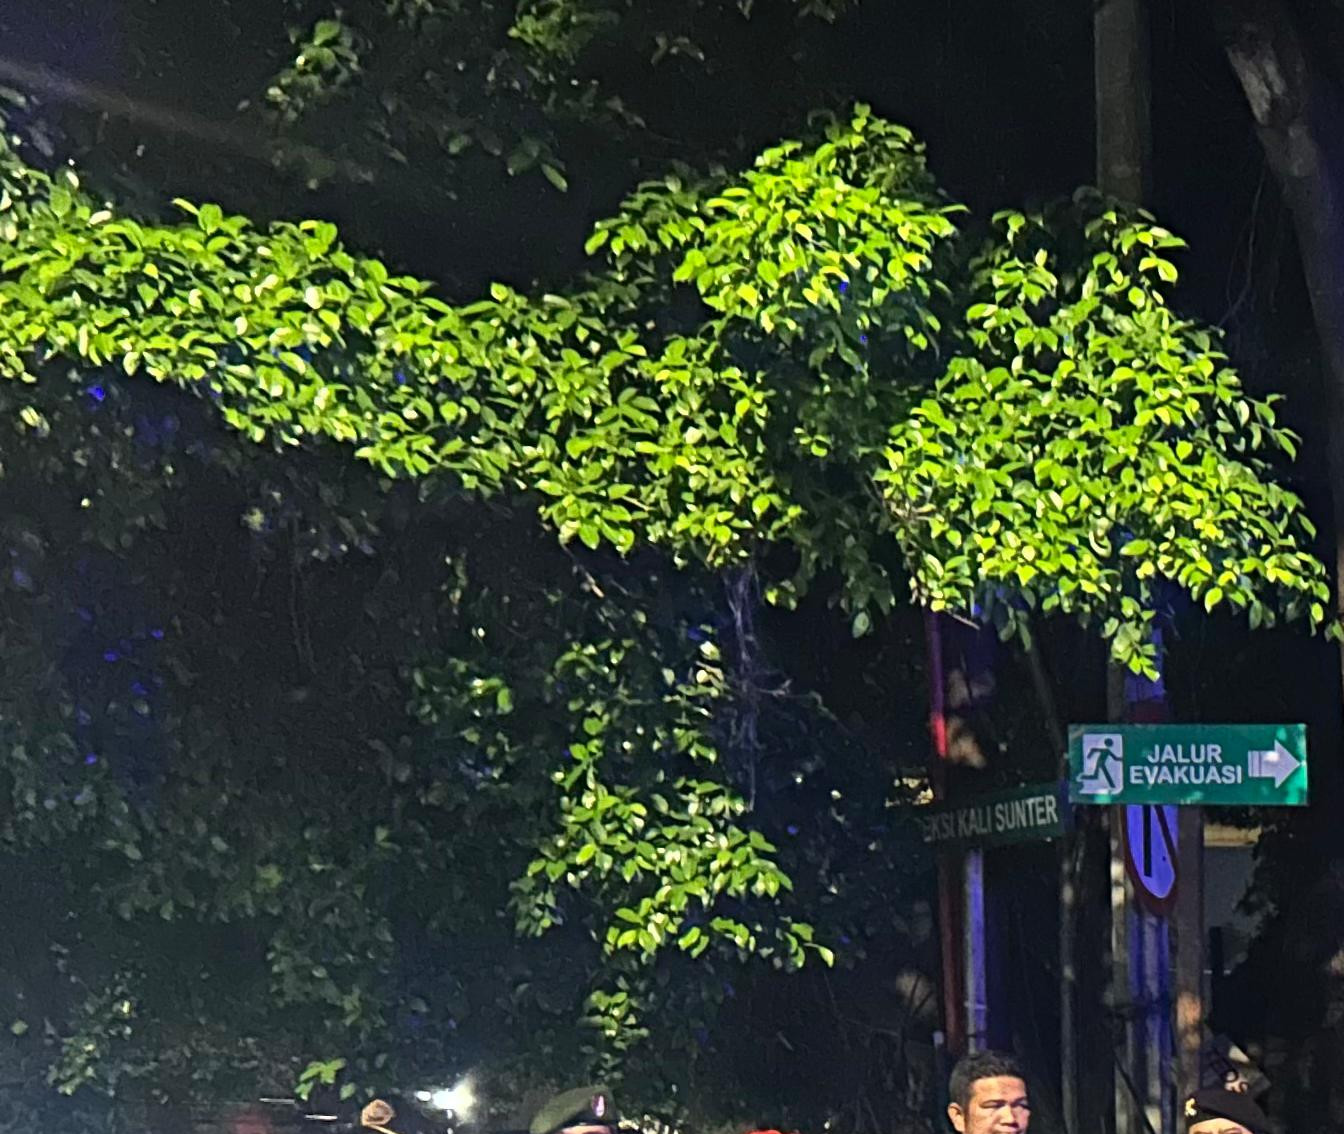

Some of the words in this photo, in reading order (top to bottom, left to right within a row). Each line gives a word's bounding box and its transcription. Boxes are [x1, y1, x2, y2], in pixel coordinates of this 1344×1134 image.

[1148, 744, 1223, 764] JALUR
[1129, 765, 1242, 785] EVAKUASI
[957, 804, 993, 838] KALI
[995, 795, 1058, 832] SUNTER
